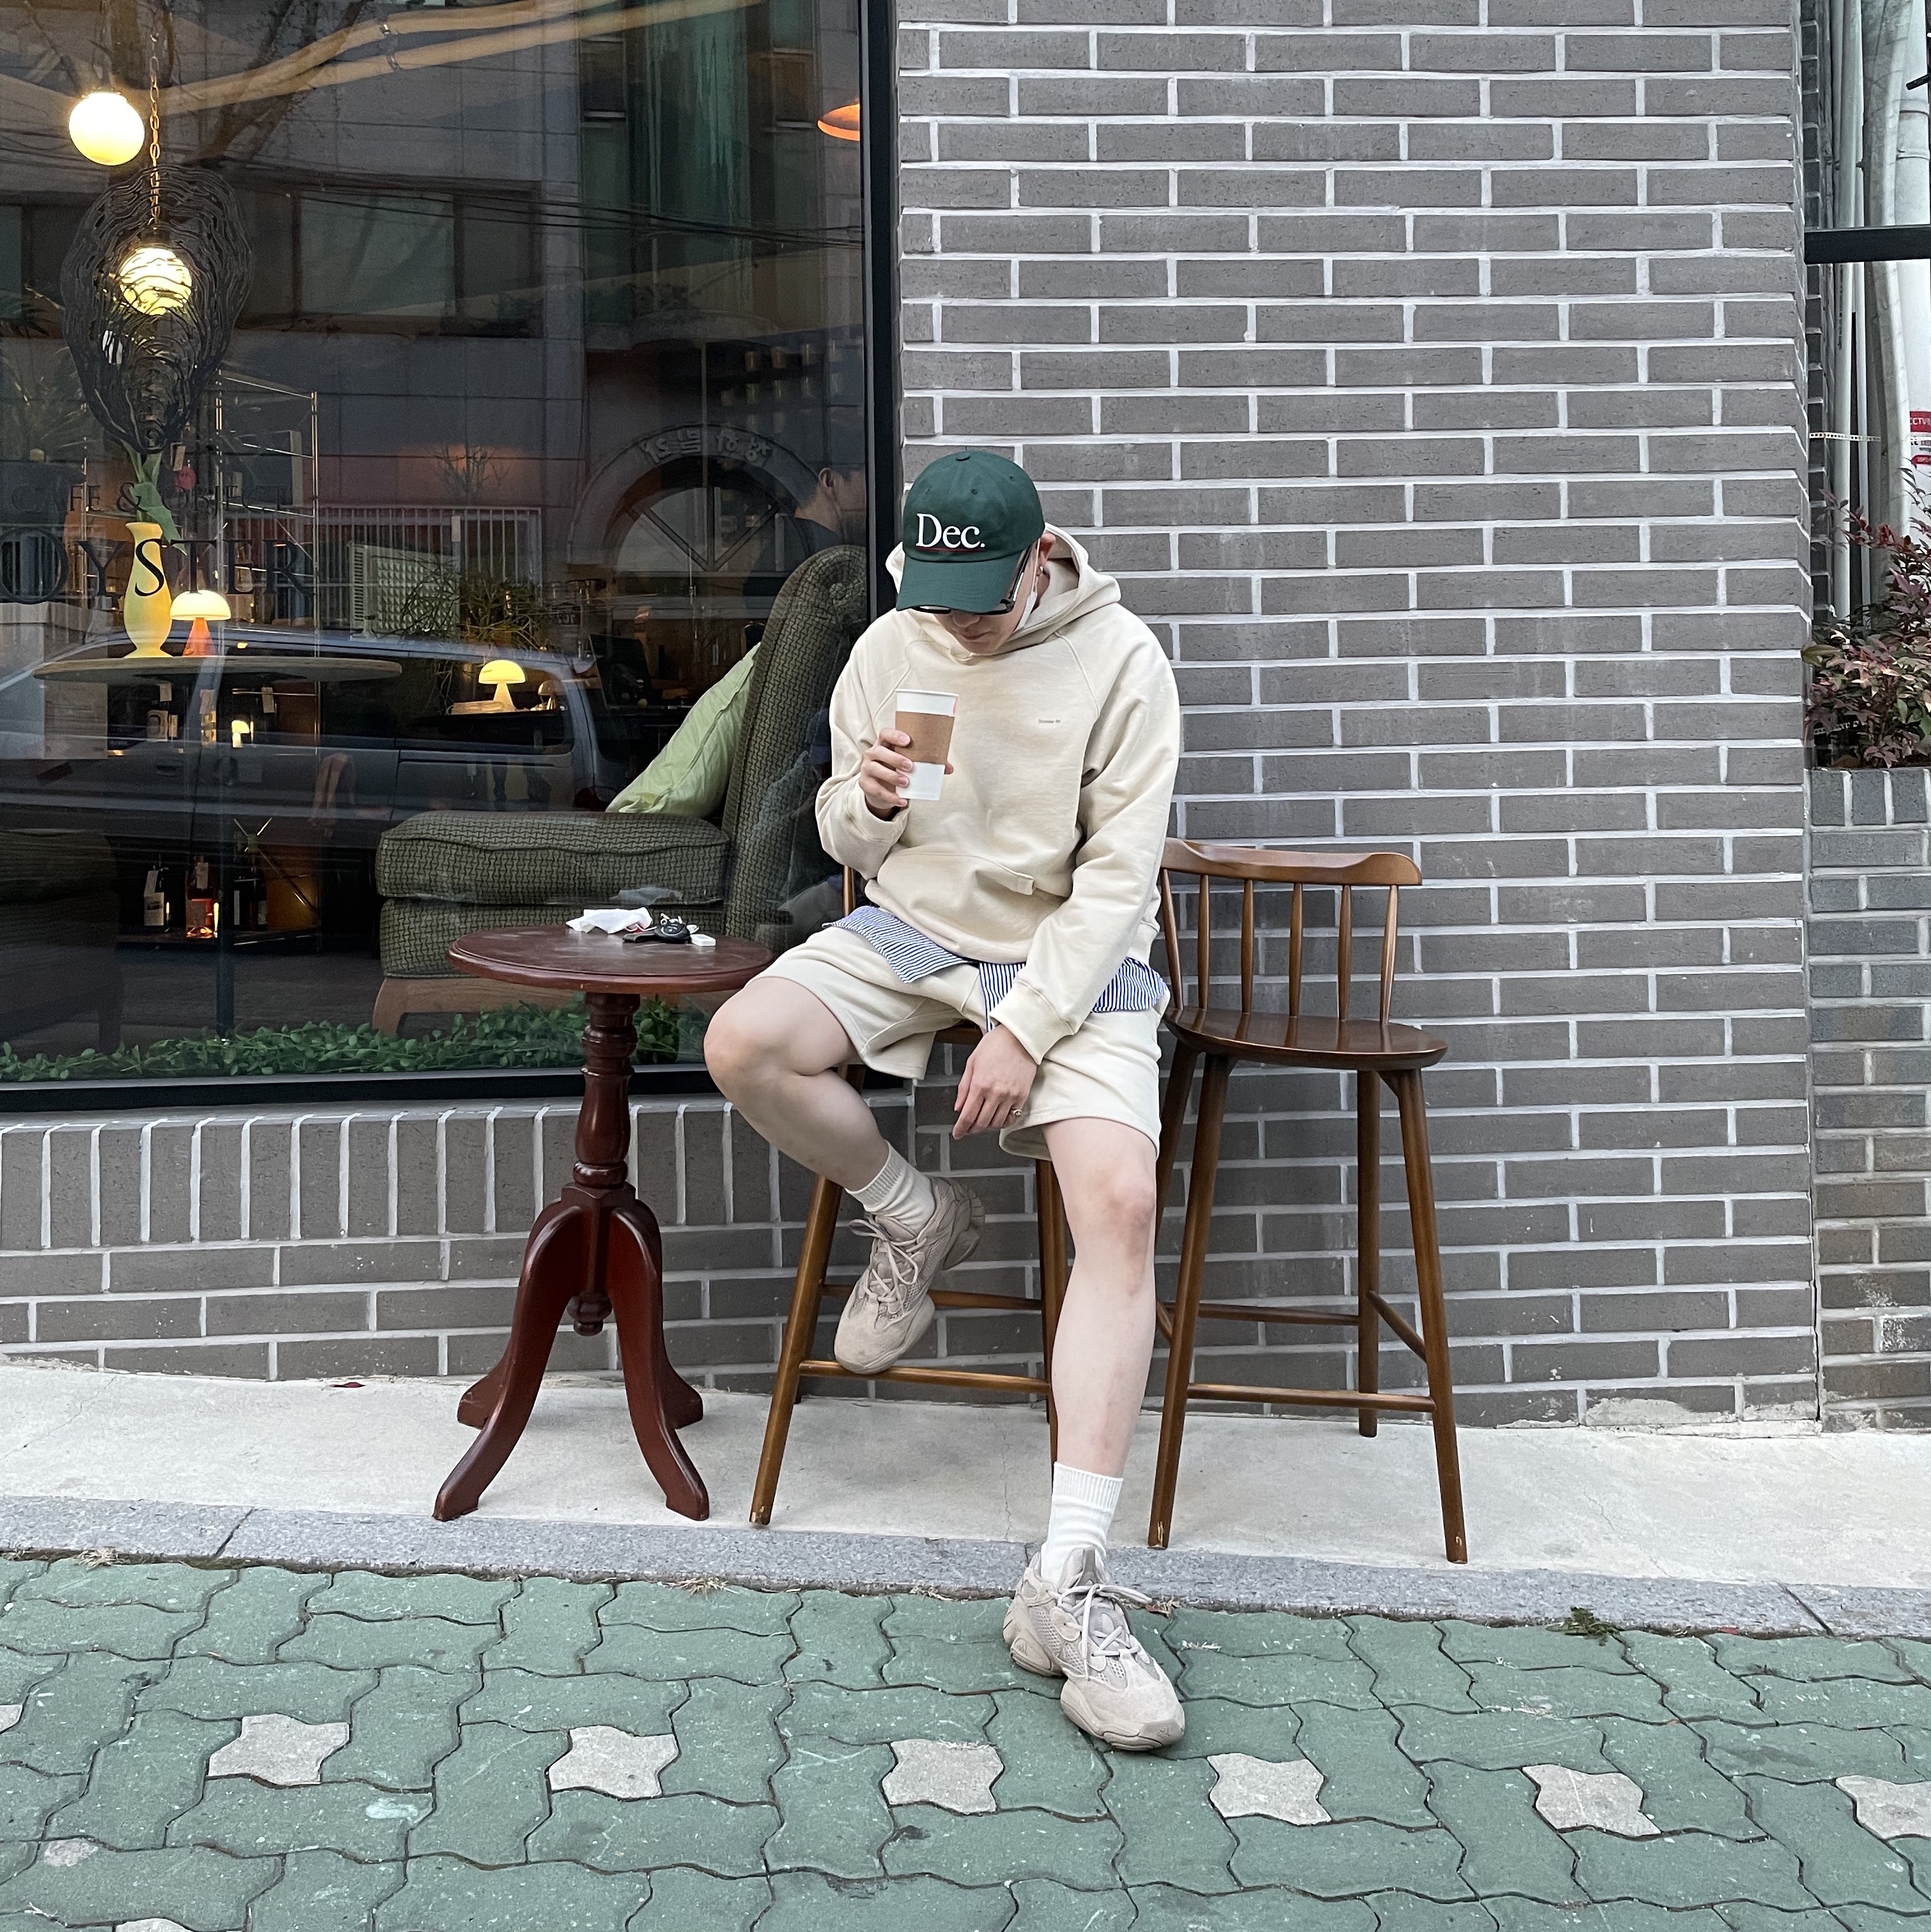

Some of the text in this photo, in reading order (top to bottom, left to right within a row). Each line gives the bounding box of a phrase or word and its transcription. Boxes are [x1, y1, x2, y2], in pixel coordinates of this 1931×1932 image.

[11, 482, 291, 517] CAFE & OBJECT
[916, 513, 985, 549] Dec.
[0, 526, 315, 605] OYSTER
